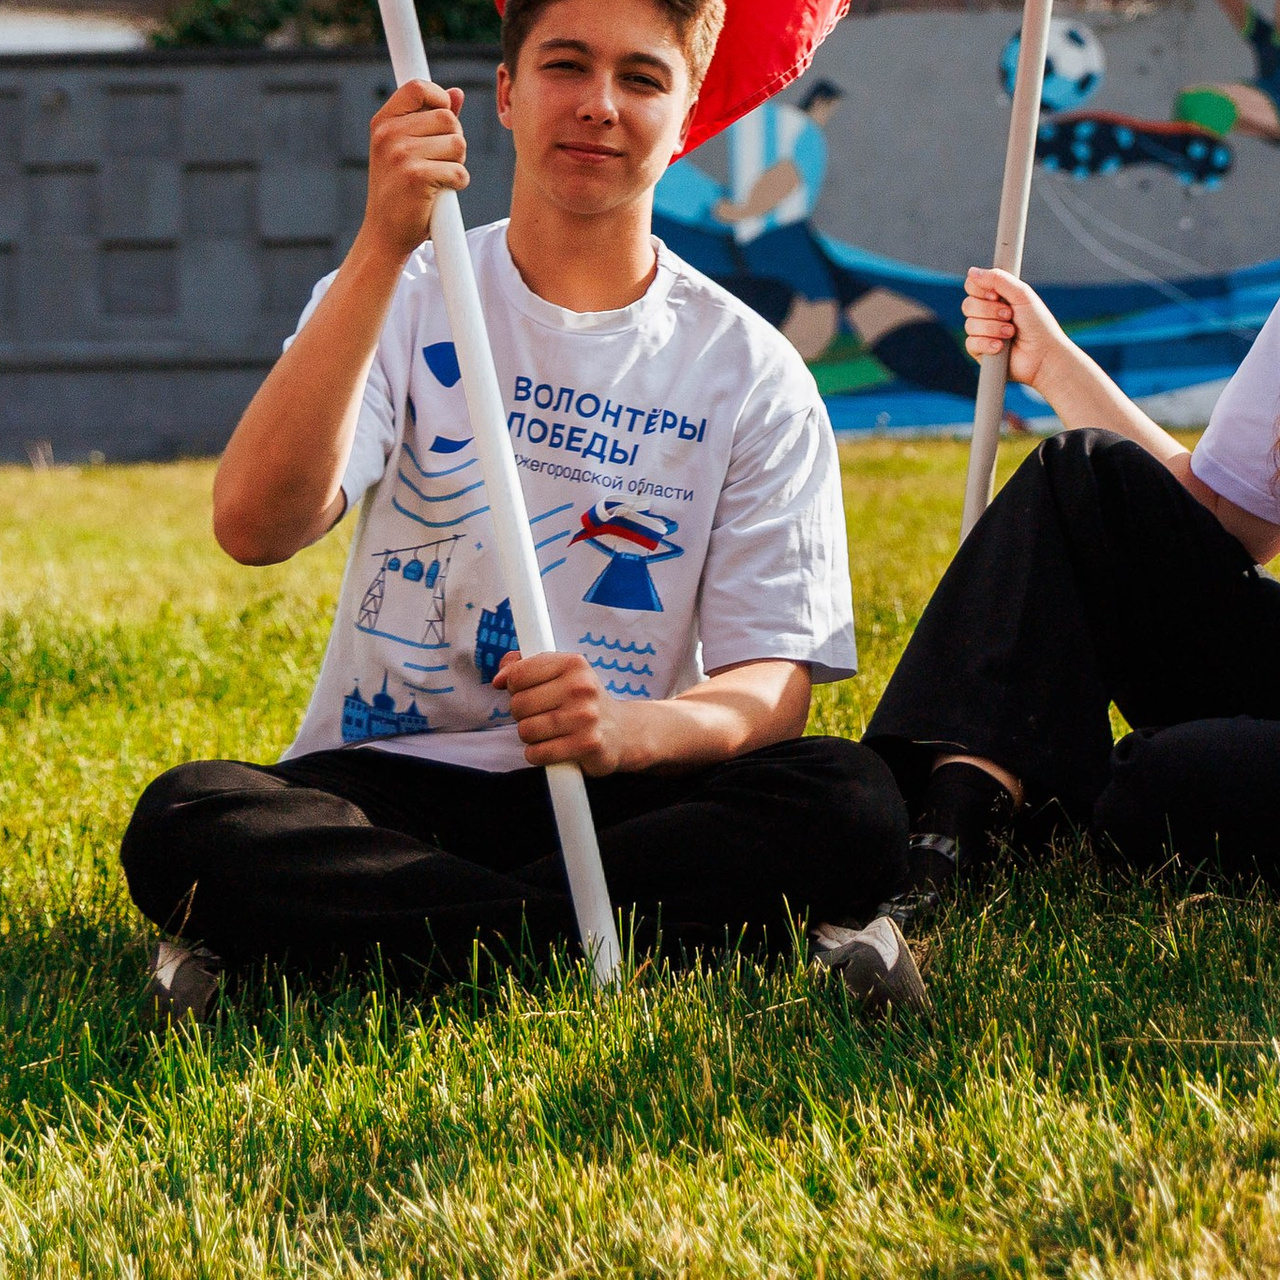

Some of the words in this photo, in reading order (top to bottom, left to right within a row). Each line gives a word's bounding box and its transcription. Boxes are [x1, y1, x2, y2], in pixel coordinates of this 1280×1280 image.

[514, 375, 707, 443] ВОЛОНТЁРЫ
[507, 411, 639, 466] ПОБЕДЫ
[515, 453, 624, 490] жегородской
[627, 478, 694, 502] области
